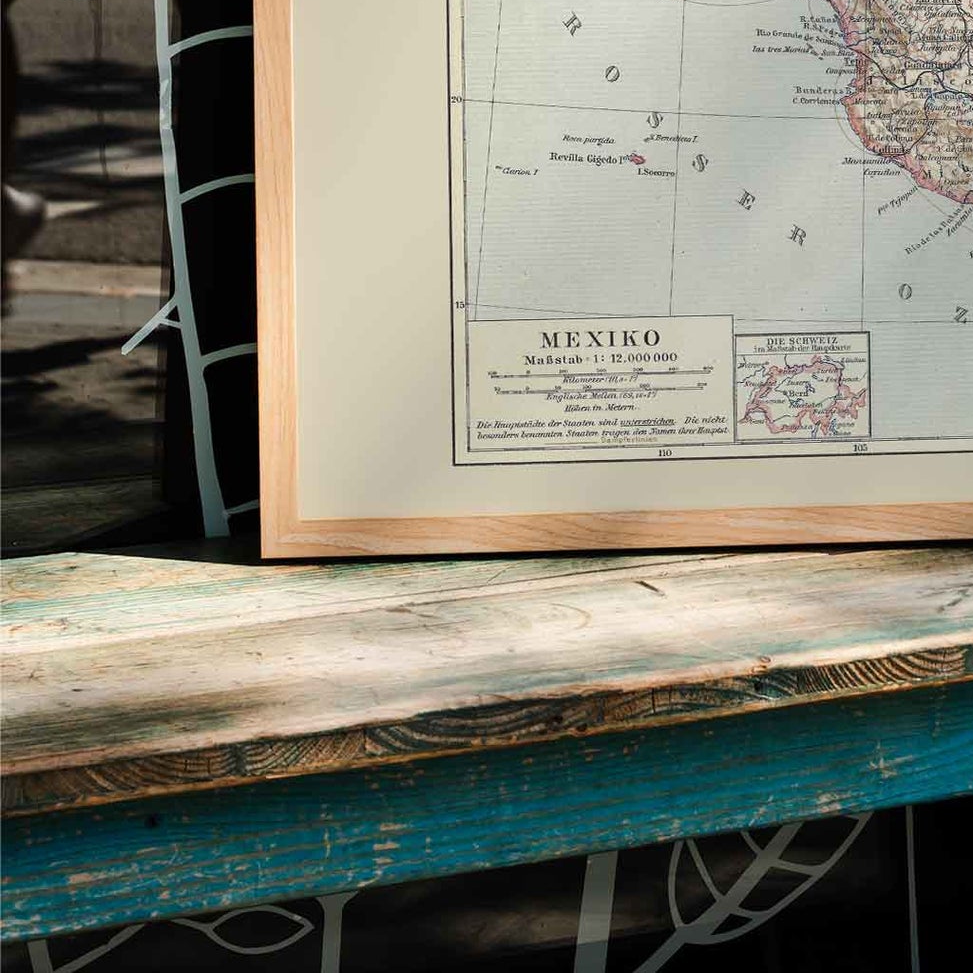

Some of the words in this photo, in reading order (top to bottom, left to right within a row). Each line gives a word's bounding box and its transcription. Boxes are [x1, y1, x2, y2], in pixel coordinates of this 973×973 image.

[539, 329, 660, 349] MEXIKO
[789, 336, 838, 345] SCHWEIZ
[524, 355, 583, 366] Maßstab
[853, 444, 868, 452] 105
